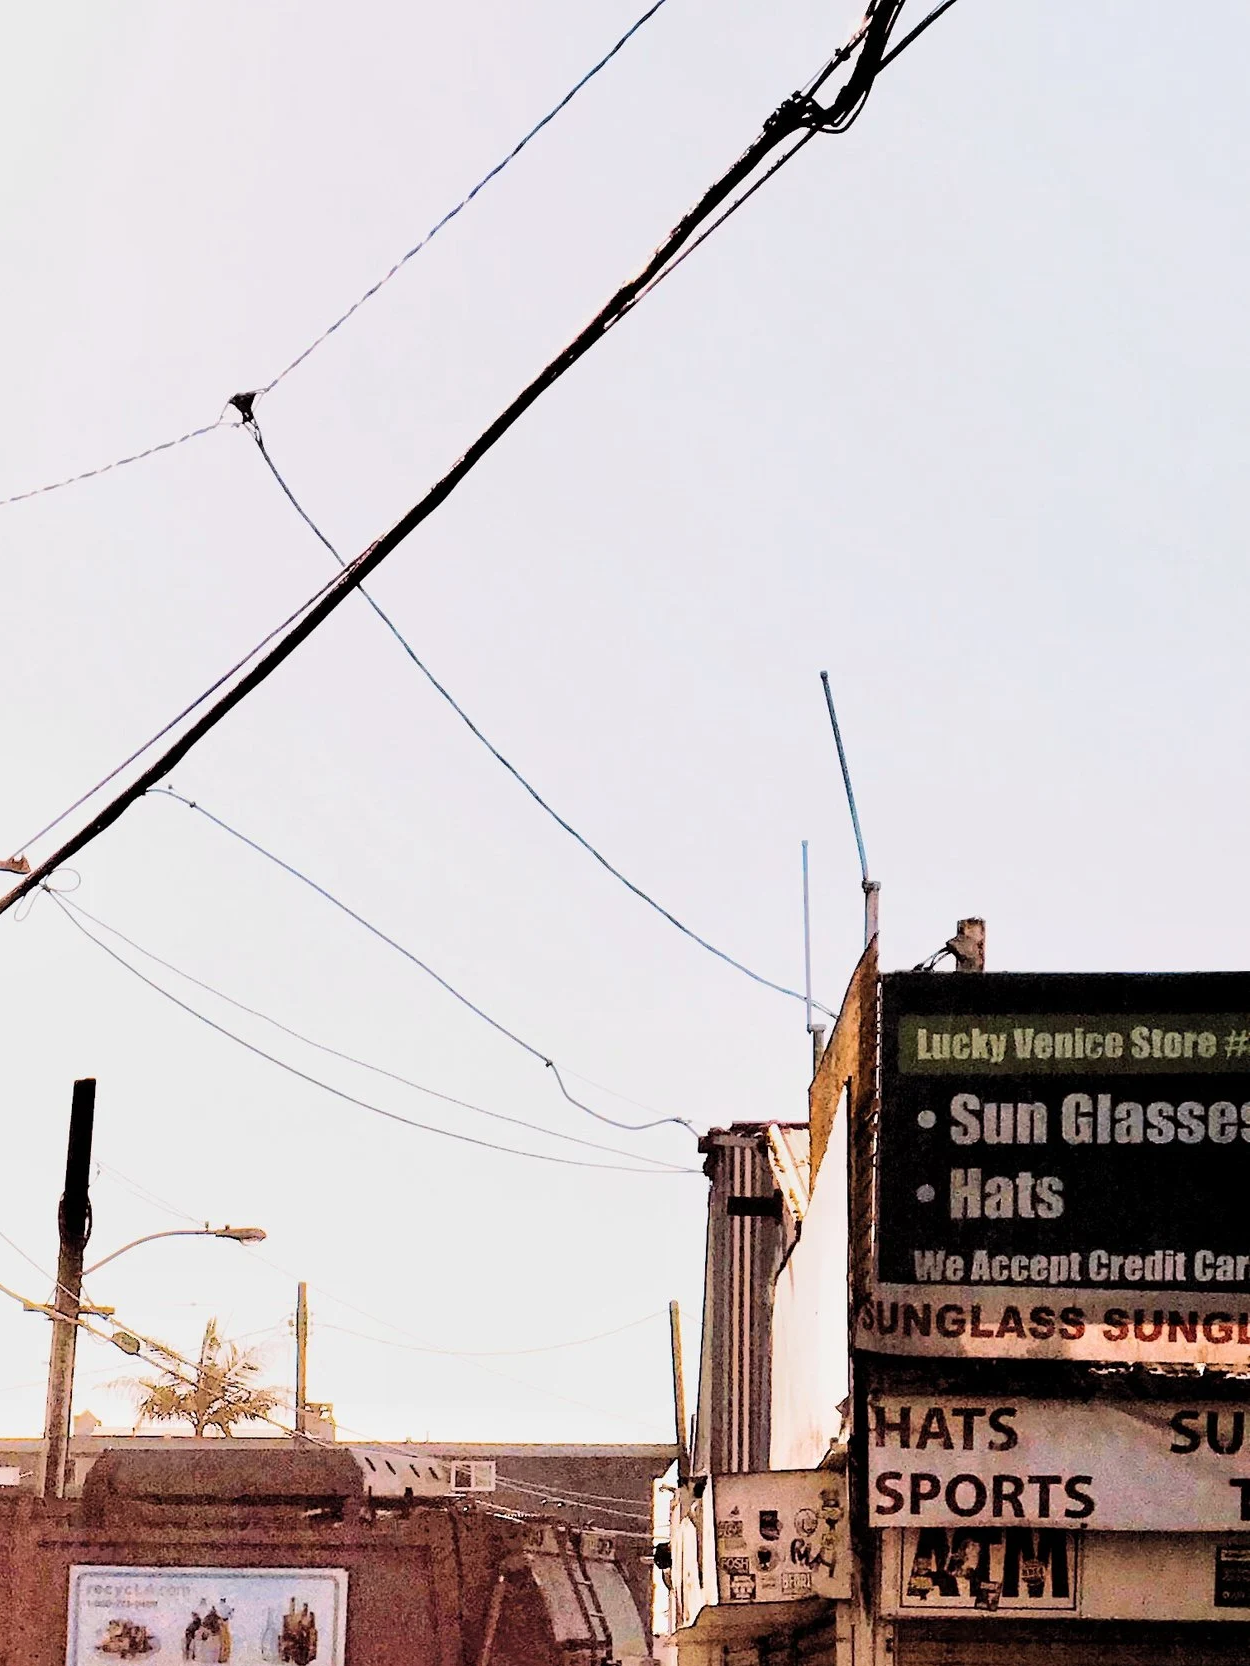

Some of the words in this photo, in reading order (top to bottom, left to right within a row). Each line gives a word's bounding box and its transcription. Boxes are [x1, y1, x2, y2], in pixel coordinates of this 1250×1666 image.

[916, 1028, 1007, 1062] Lucky
[1014, 1028, 1123, 1060] Venice
[1131, 1026, 1217, 1060] Store
[949, 1093, 1048, 1145] Sun
[949, 1168, 1065, 1220] Hats
[914, 1250, 965, 1282] We
[971, 1250, 1082, 1285] Accept
[1088, 1250, 1186, 1283] Credit
[858, 1300, 1086, 1340] SUNGLASS
[876, 1405, 1019, 1452] HATS
[875, 1471, 1096, 1519] SPORTS
[907, 1528, 1070, 1598] ATM
